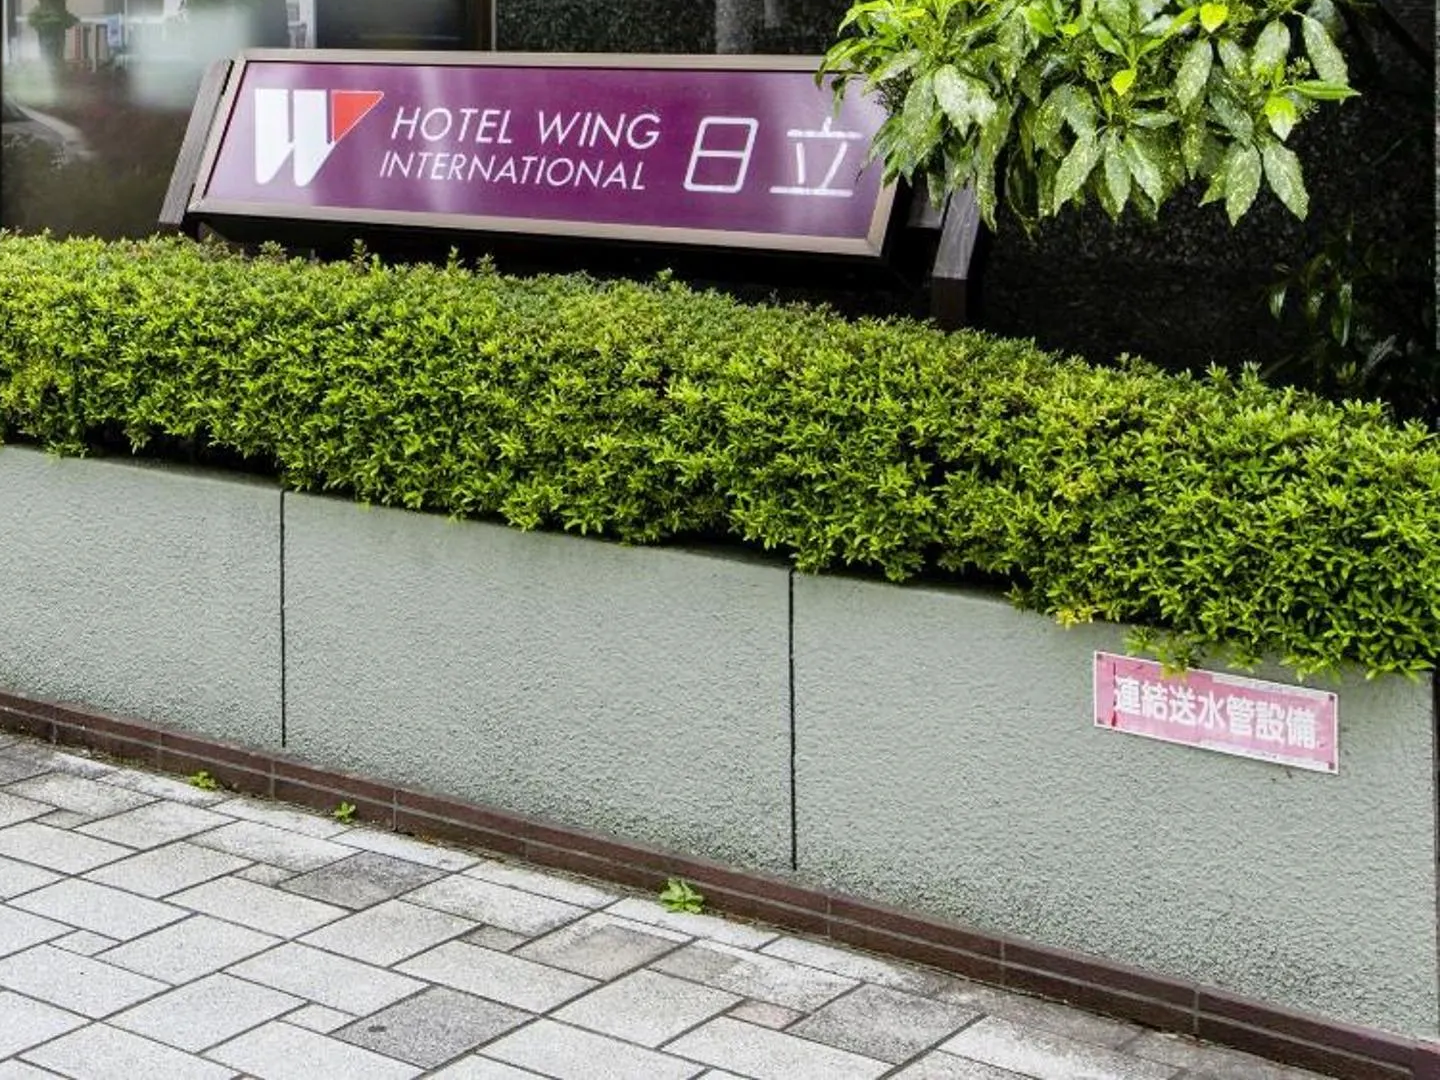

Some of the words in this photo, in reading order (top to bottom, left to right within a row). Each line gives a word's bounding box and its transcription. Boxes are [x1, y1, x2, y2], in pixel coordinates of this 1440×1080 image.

[391, 107, 514, 146] HOTEL
[537, 110, 661, 151] WING
[682, 116, 861, 198] 日立
[379, 150, 646, 191] INTERNATIONAL
[1113, 676, 1318, 750] 連結送水管設備
